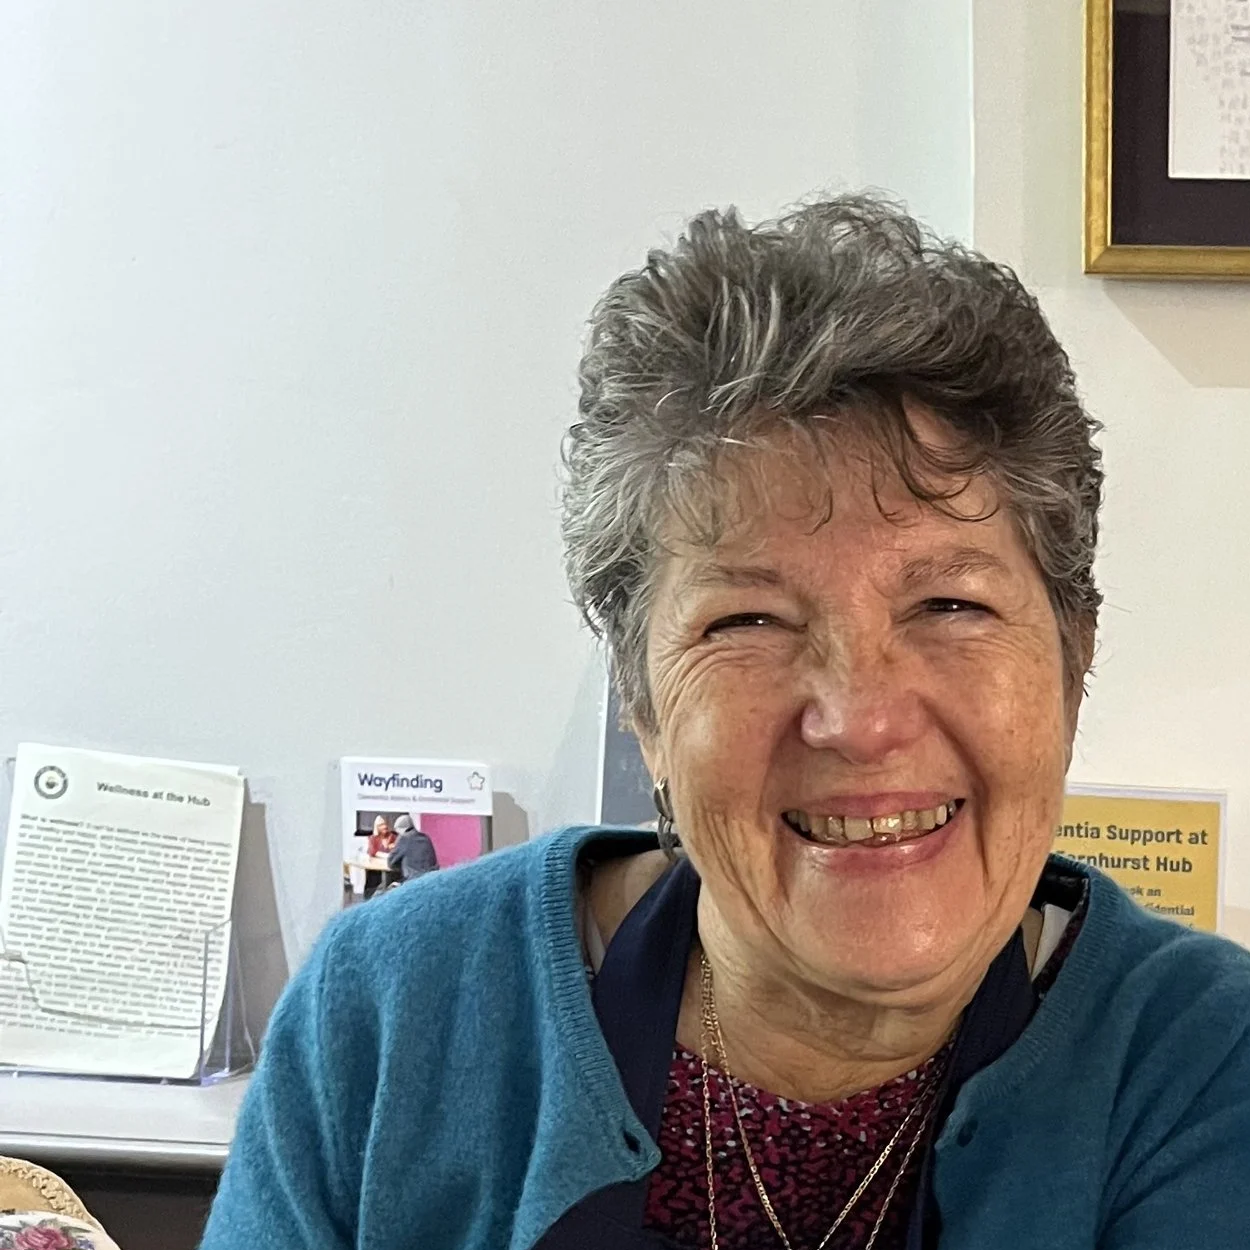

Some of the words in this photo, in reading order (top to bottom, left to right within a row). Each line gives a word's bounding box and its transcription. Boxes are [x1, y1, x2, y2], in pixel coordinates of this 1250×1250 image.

[358, 773, 443, 793] Wayfinding
[97, 782, 149, 798] Wellness
[152, 792, 163, 800] at
[167, 792, 184, 802] the
[187, 795, 210, 806] Hub
[1107, 825, 1182, 846] Support
[1188, 829, 1208, 845] at
[1156, 856, 1193, 873] Hub
[1147, 888, 1162, 897] an
